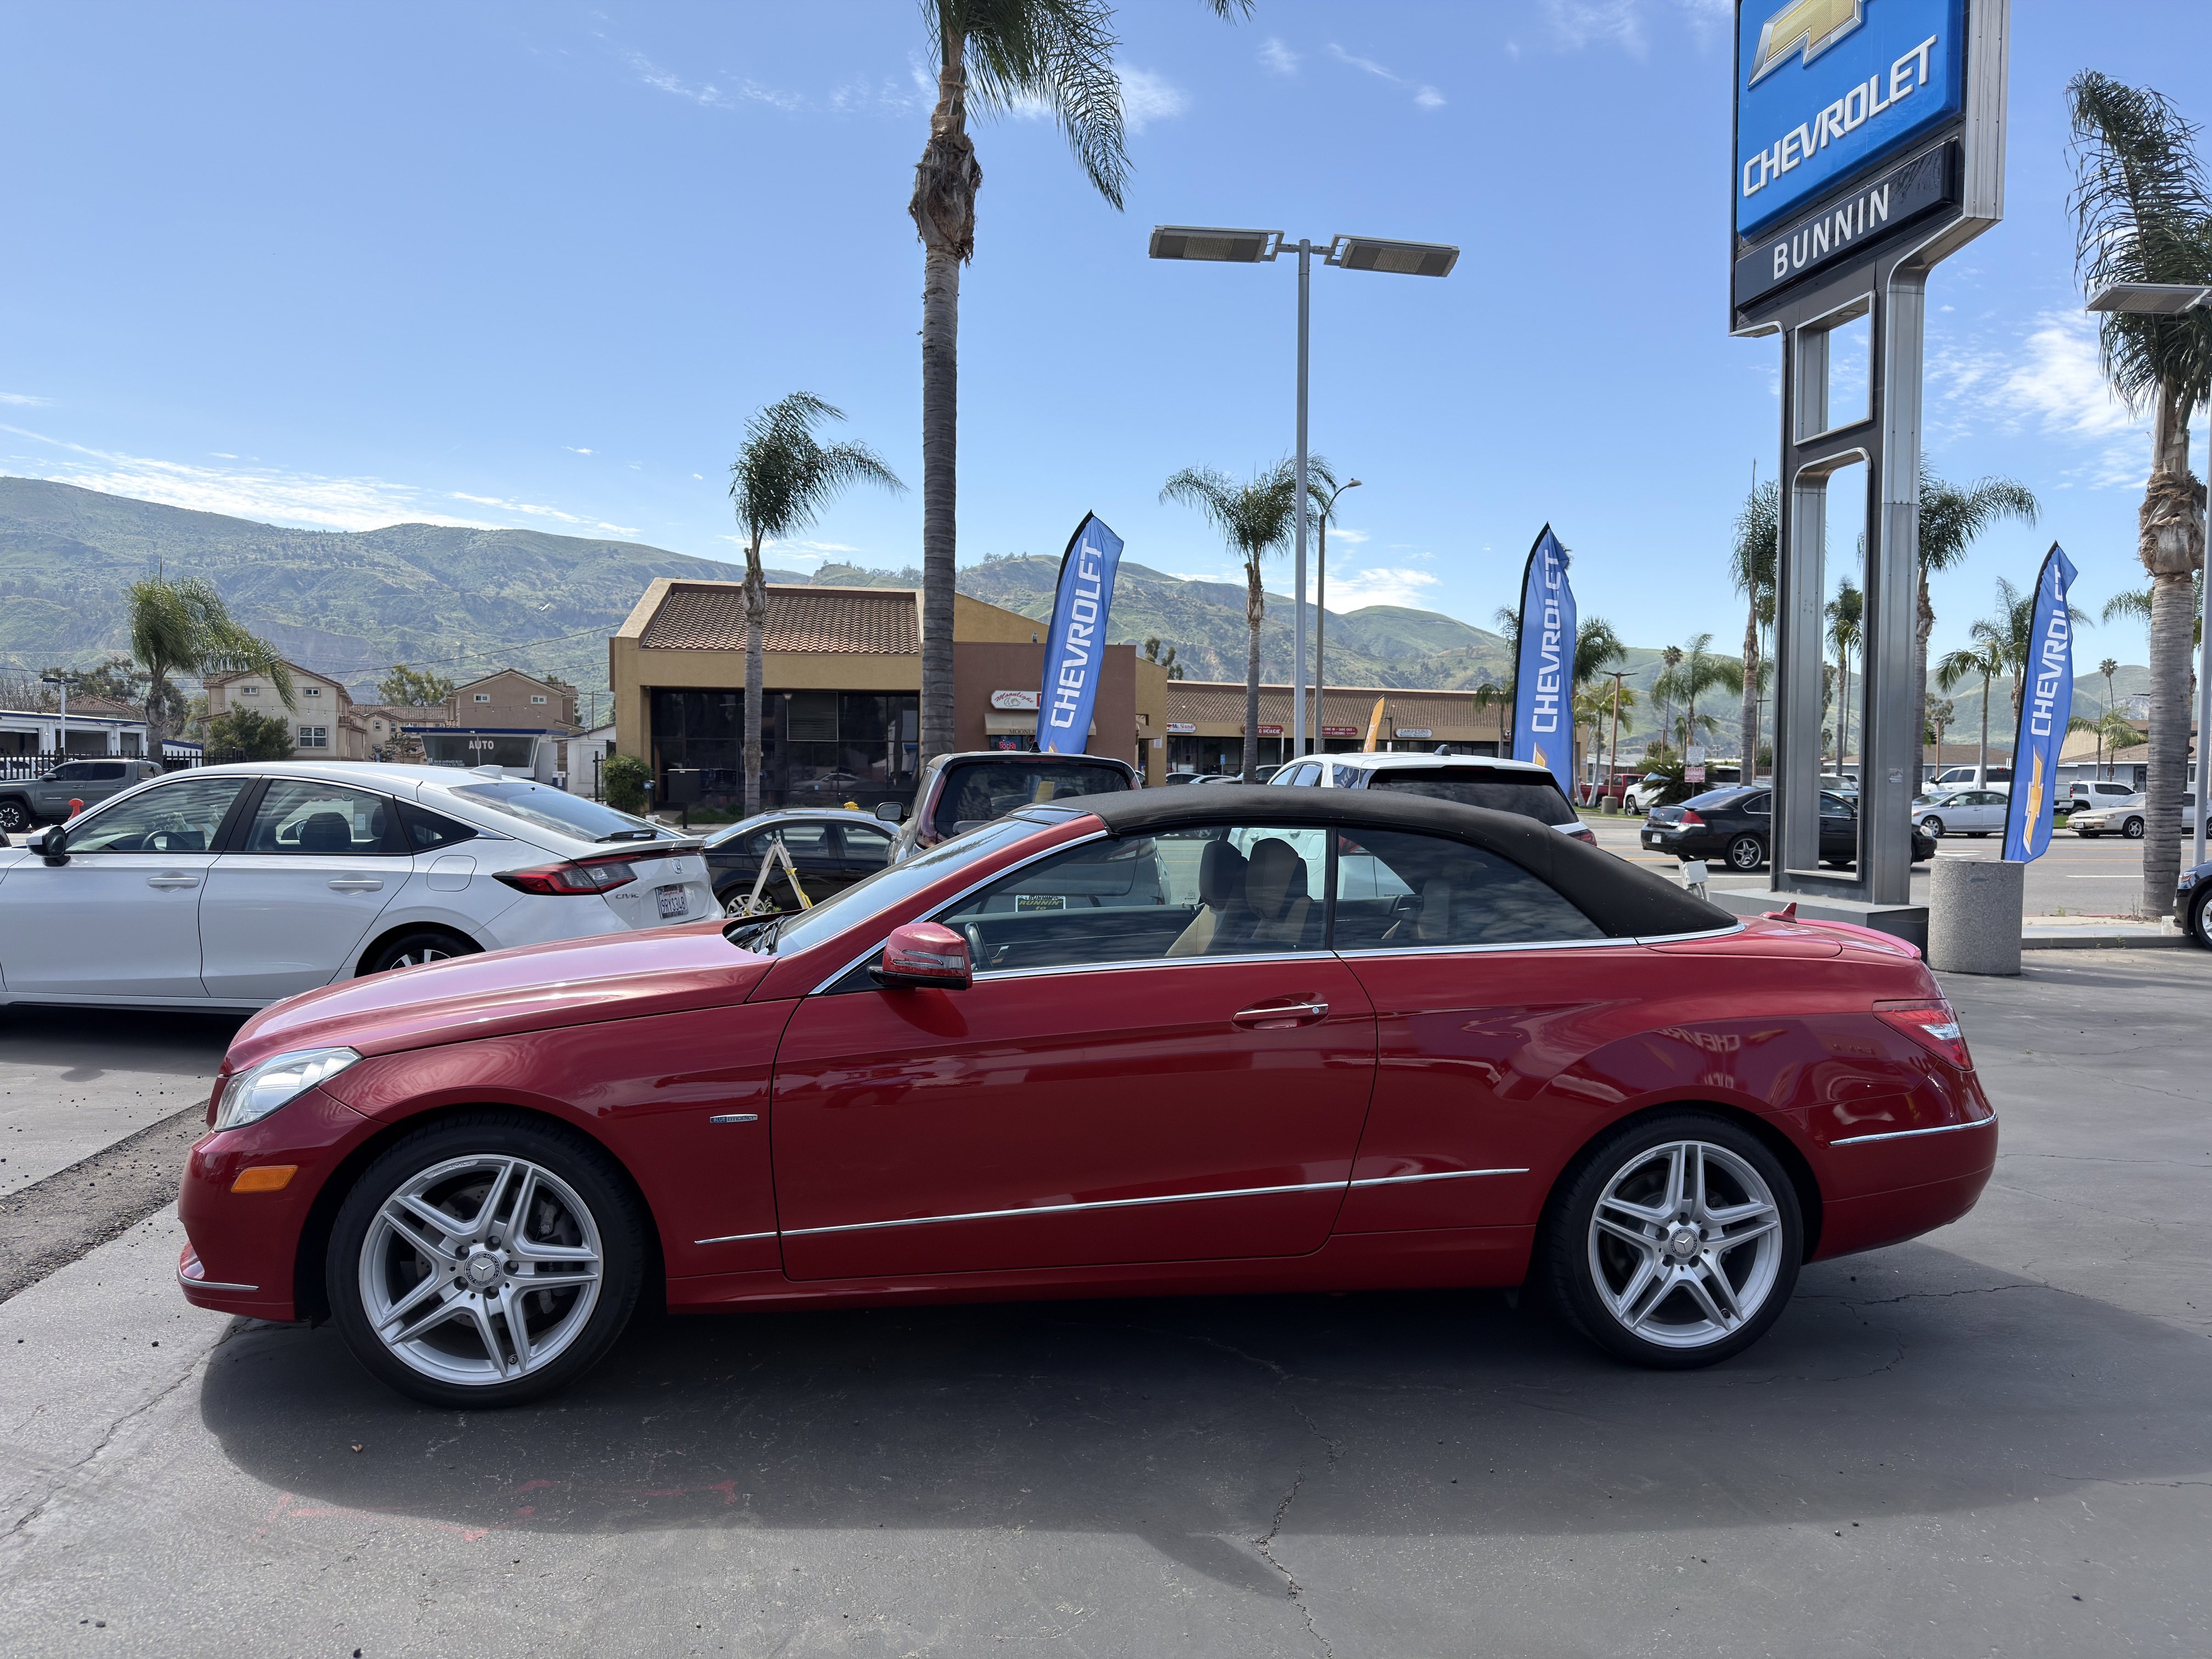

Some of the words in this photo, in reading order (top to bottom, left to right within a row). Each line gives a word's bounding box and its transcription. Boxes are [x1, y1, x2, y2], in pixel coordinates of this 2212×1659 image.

[1743, 35, 1938, 198] CHEVROLET
[1774, 183, 1889, 280] BUNNIN
[1050, 538, 1102, 729] CHEVROLET
[1532, 549, 1561, 732] CHEVROLET
[469, 741, 494, 749] AUTO
[661, 896, 686, 913] 9RYS348
[445, 1161, 471, 1170] AMG
[485, 1254, 500, 1275] MERCEDES
[466, 1270, 476, 1283] BENZ
